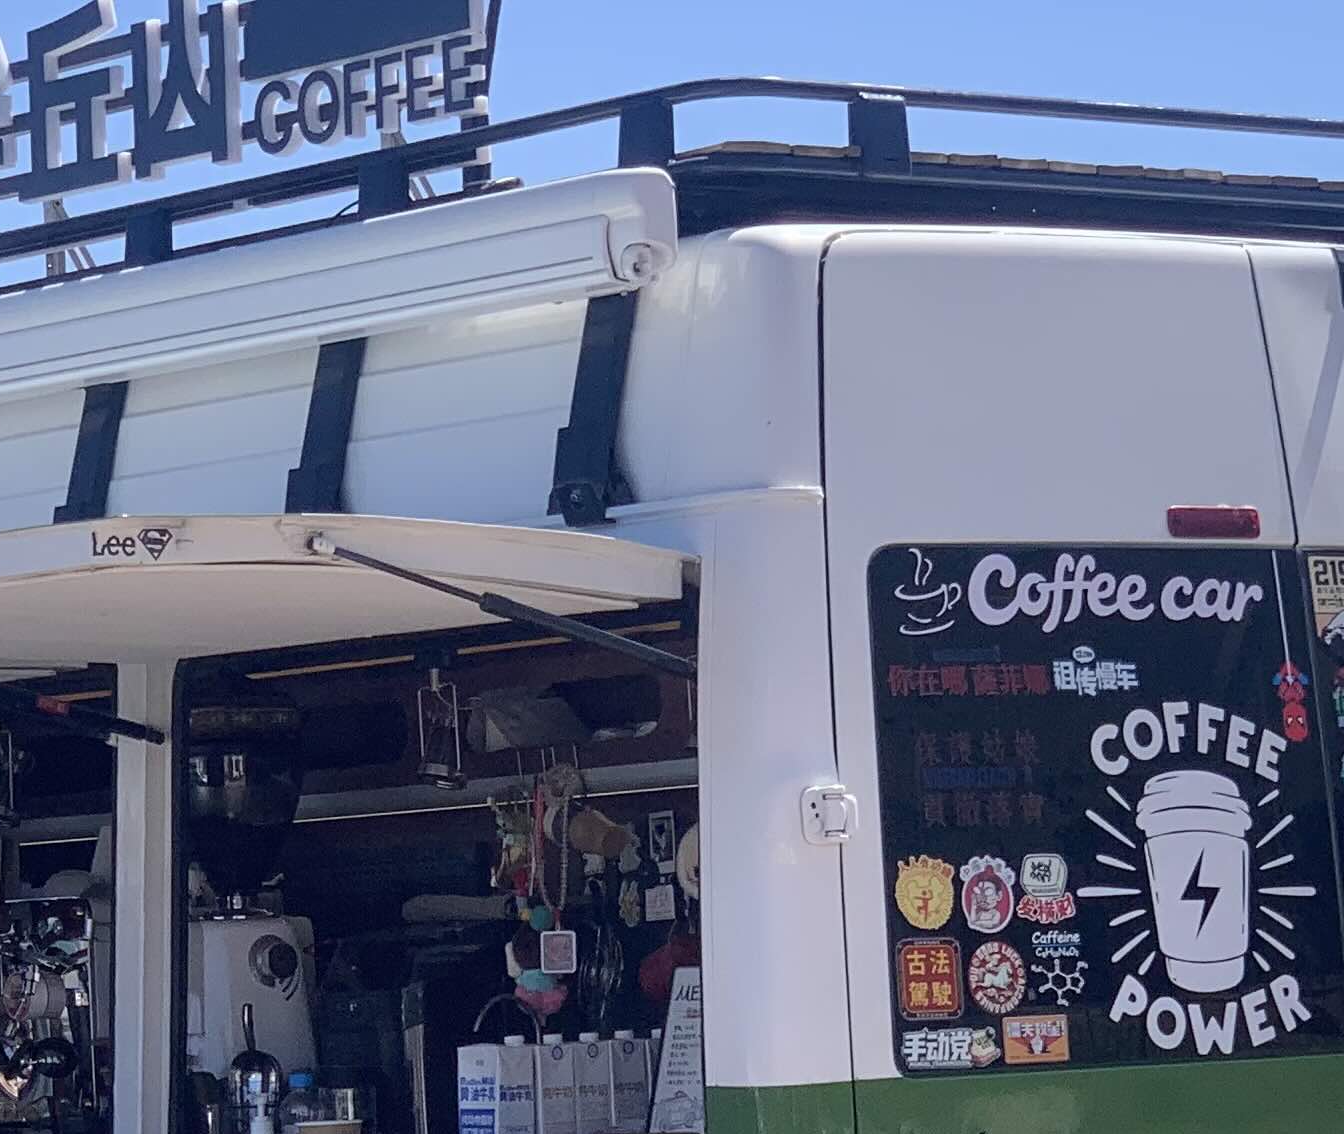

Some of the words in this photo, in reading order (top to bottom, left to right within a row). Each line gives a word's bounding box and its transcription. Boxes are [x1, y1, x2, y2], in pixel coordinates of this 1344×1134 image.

[255, 33, 486, 154] COFFEE
[91, 531, 136, 557] Lee
[967, 553, 1154, 633] Coffee
[1160, 575, 1263, 622] car
[1053, 661, 1139, 696] 祖传慢车
[1090, 700, 1288, 783] COFFEE
[1031, 930, 1081, 945] Caffeine
[906, 950, 951, 976] 古法
[909, 981, 952, 1007] 駕駛
[1108, 974, 1312, 1056] POWER
[903, 1030, 973, 1061] 手动党
